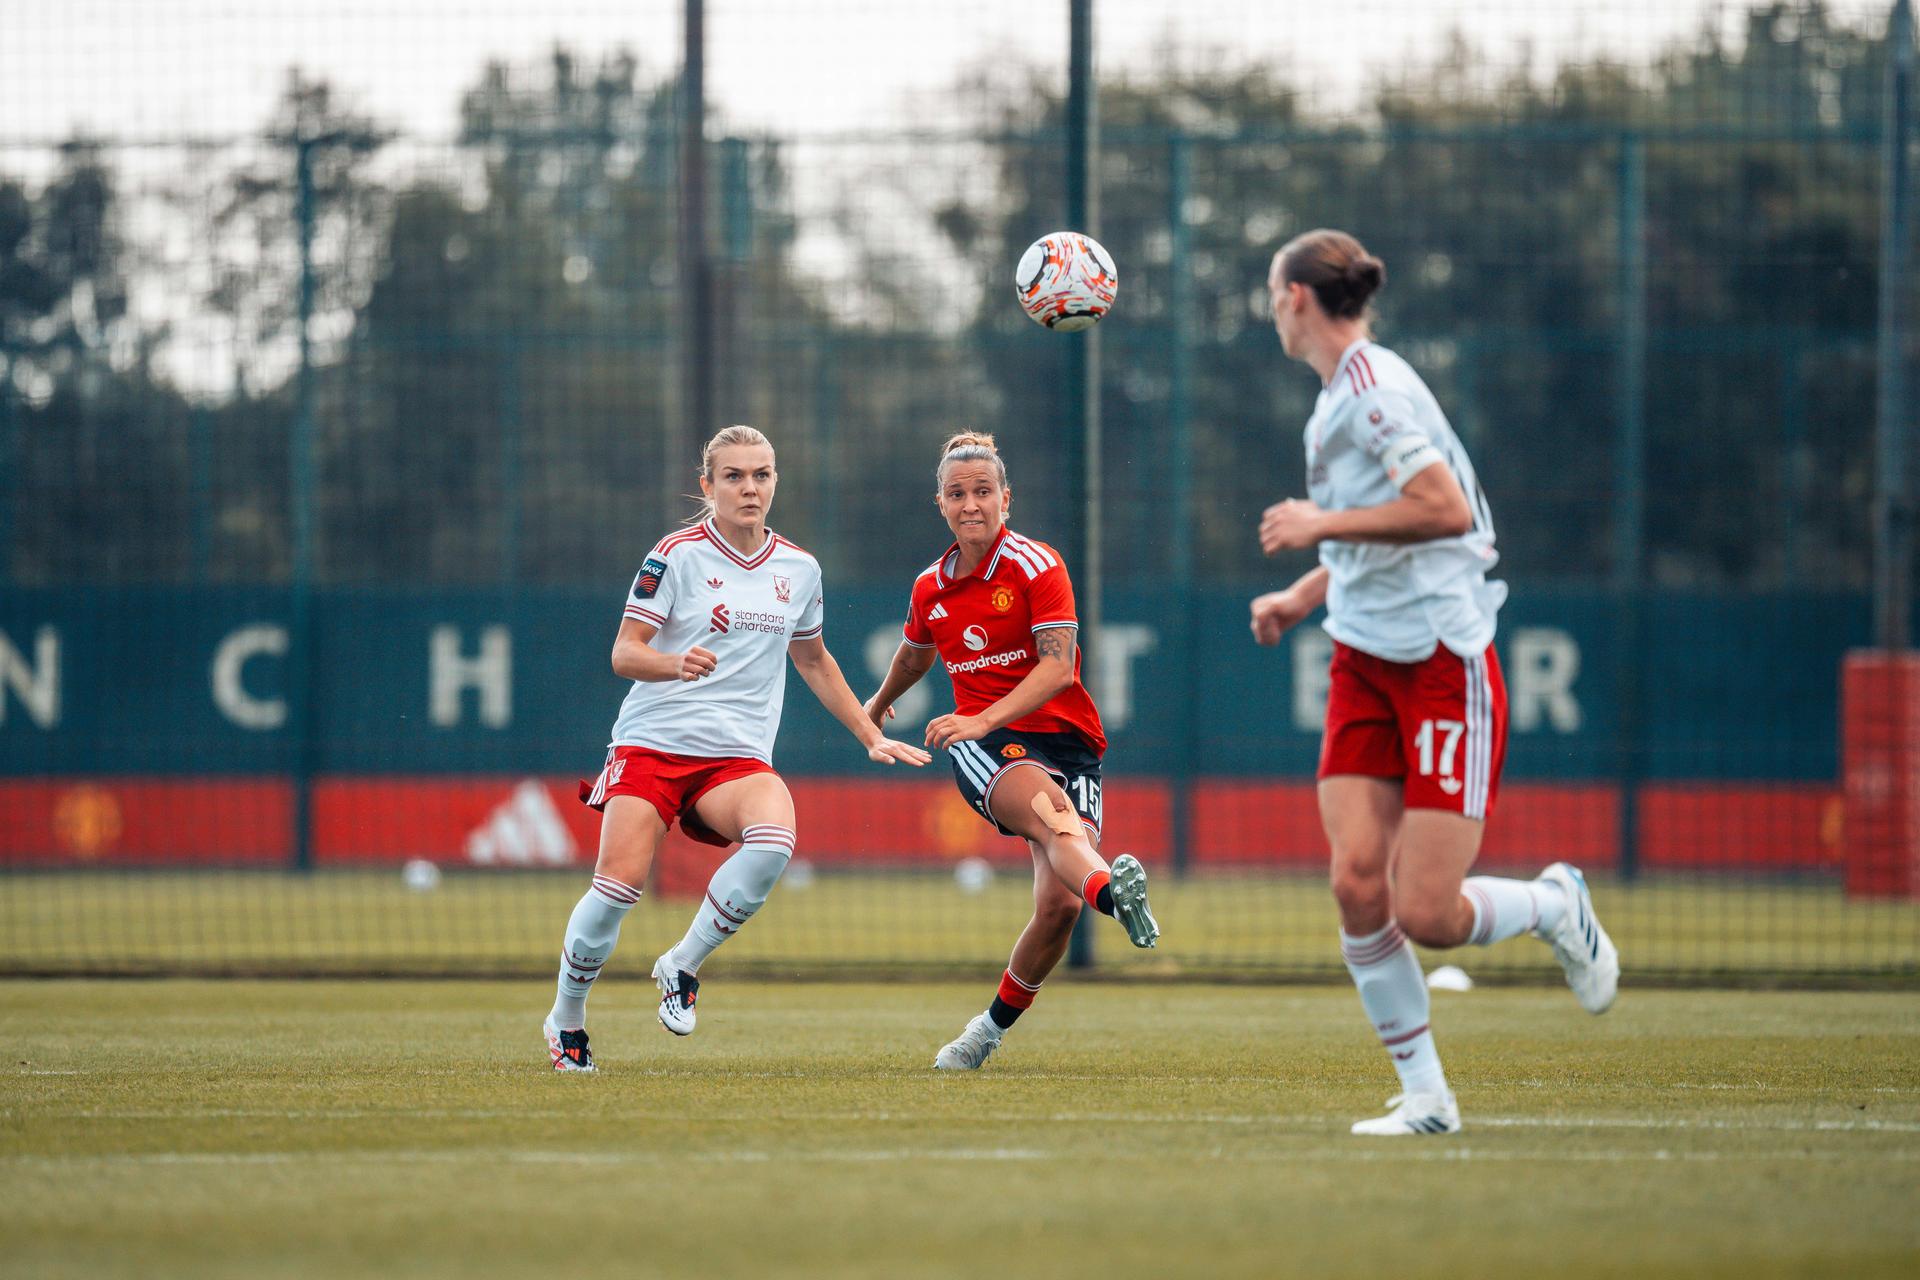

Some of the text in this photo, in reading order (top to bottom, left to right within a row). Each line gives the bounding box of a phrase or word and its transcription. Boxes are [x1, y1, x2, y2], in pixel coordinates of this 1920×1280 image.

[735, 609, 785, 624] standard
[734, 620, 786, 635] chartered
[946, 649, 1027, 674] Snapdragon
[1415, 719, 1465, 776] 17
[1071, 775, 1100, 821] 15
[572, 951, 604, 963] LFC
